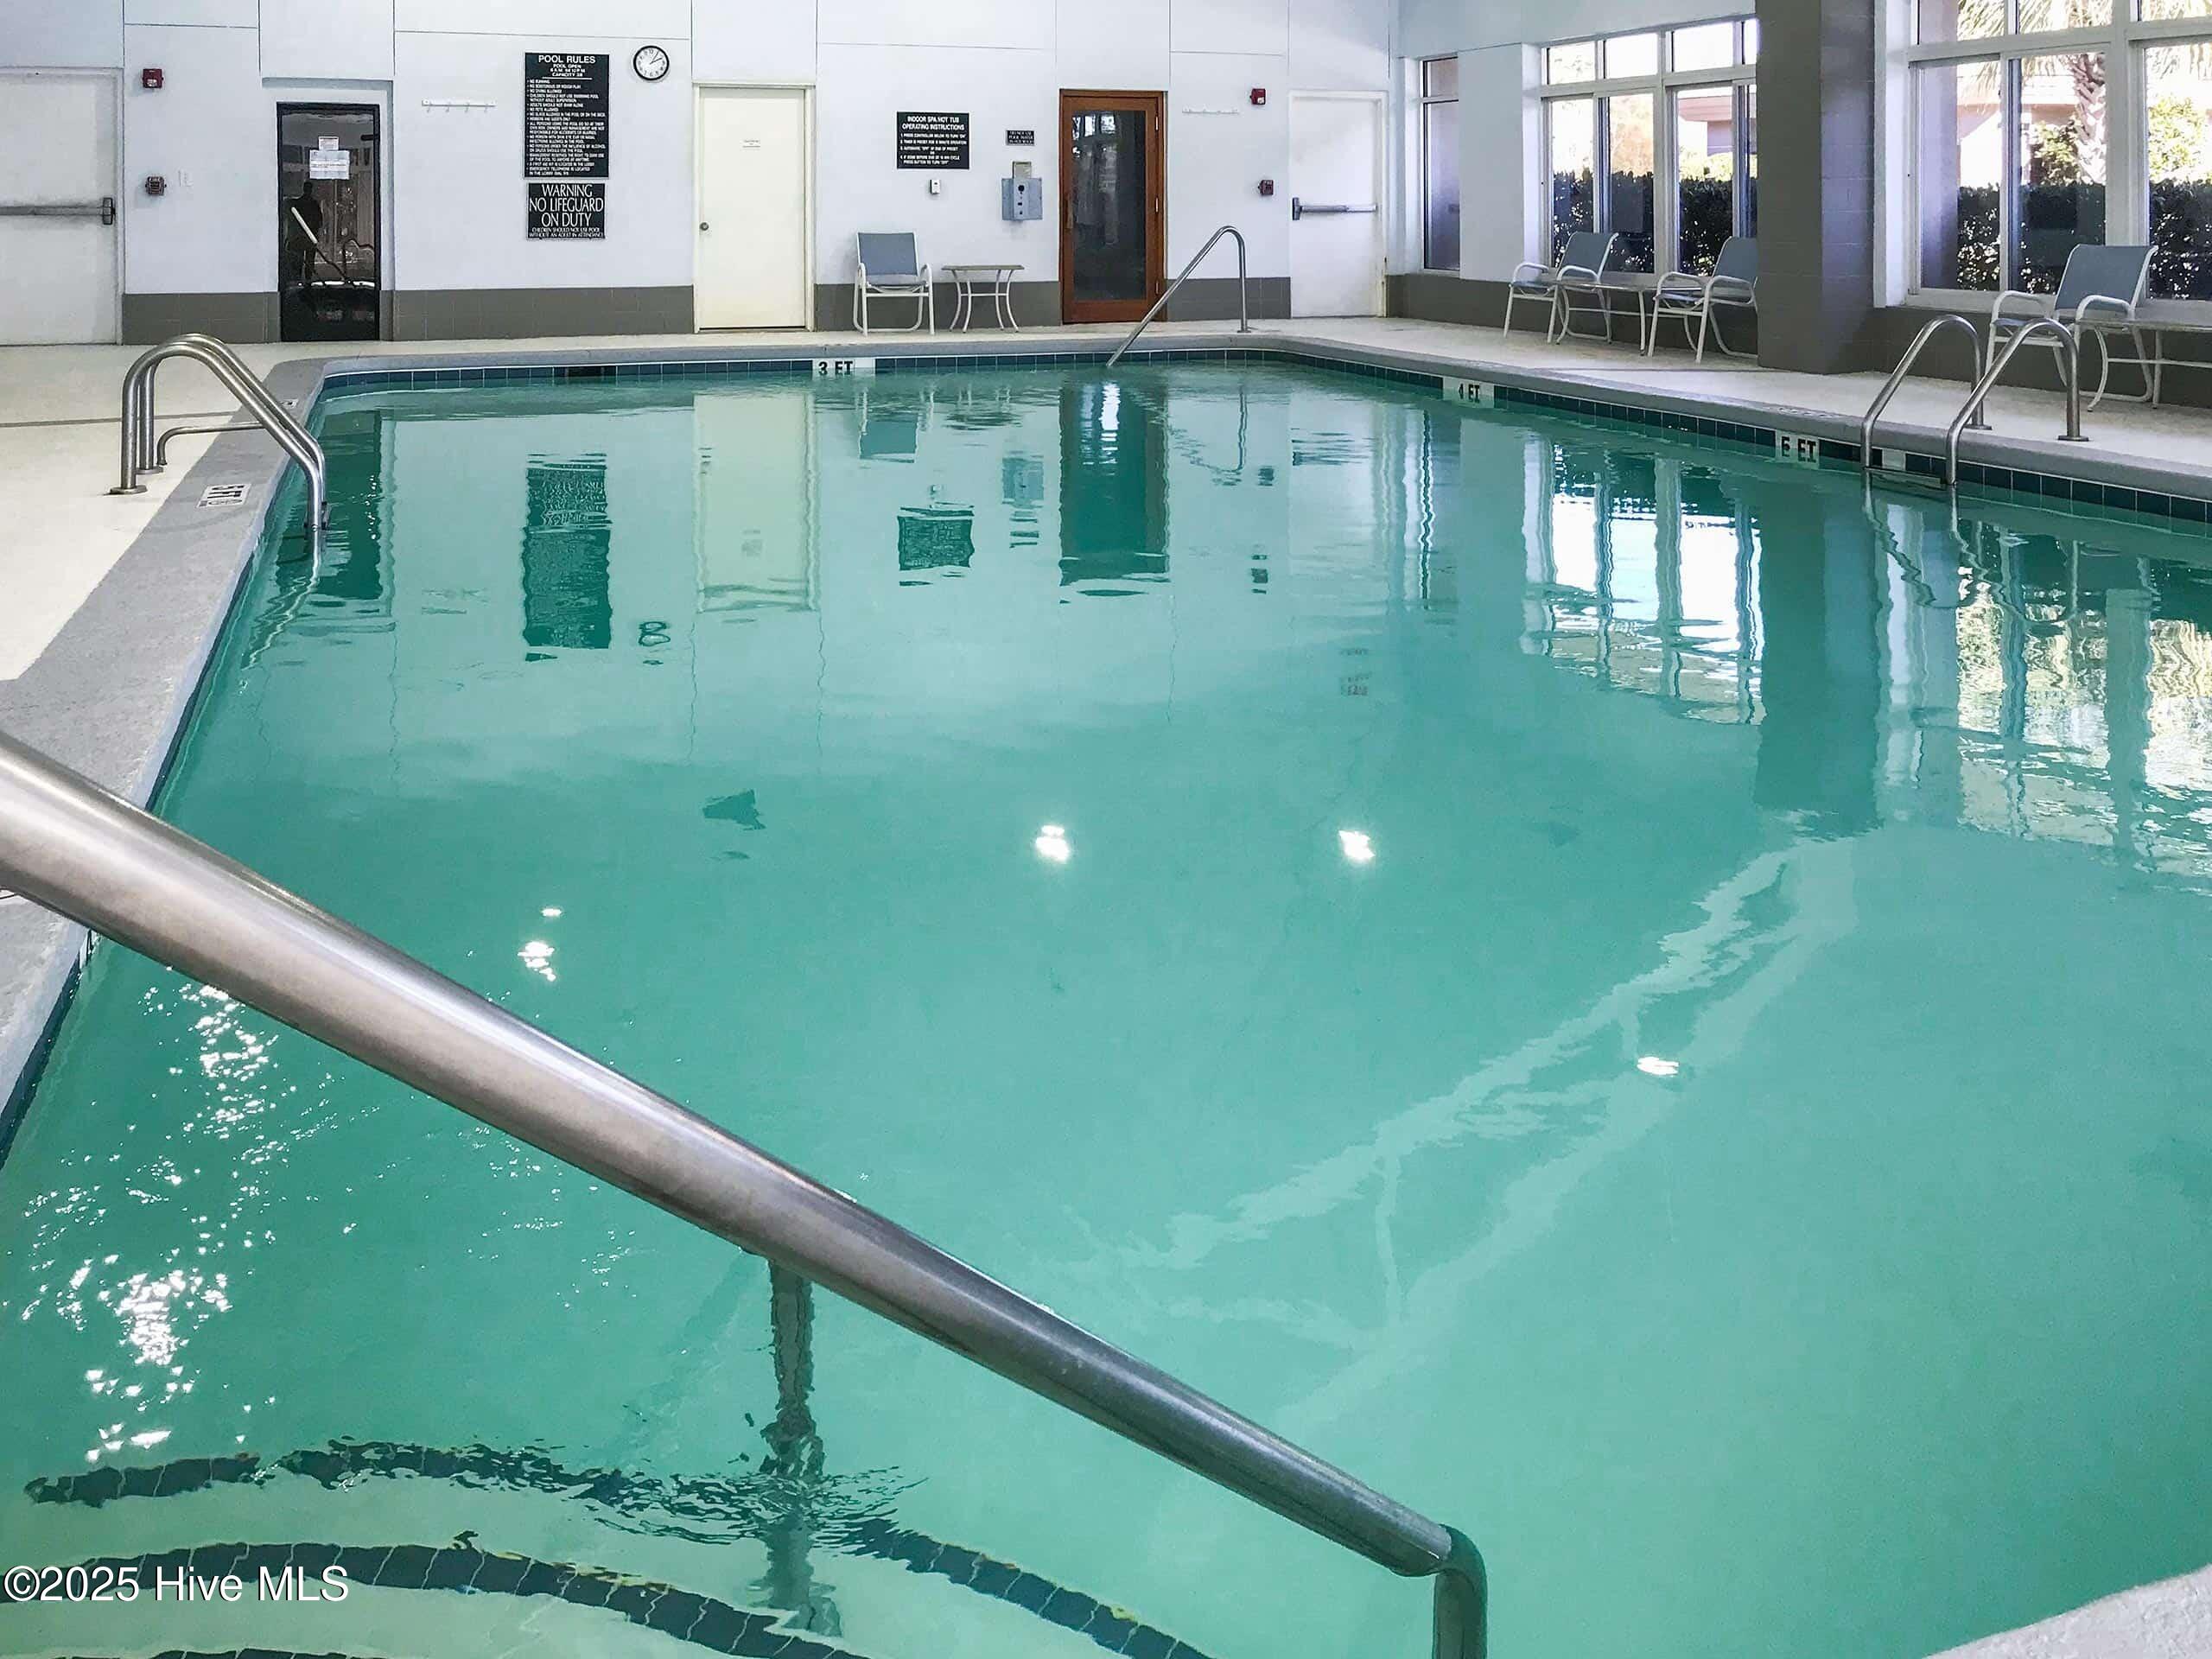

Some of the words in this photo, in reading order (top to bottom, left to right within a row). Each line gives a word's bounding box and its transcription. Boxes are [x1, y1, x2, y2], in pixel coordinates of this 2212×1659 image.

[538, 55, 563, 63] POOL
[567, 55, 596, 64] RULES
[541, 184, 592, 197] WARNING
[529, 197, 546, 212] NO
[550, 197, 604, 212] LIFEGUARD
[541, 212, 558, 227] ON
[562, 213, 592, 227] DUTY
[819, 361, 828, 375] 3
[835, 361, 853, 375] FT
[1458, 383, 1463, 399] 4
[1469, 384, 1479, 403] FT
[1798, 438, 1816, 463] FT
